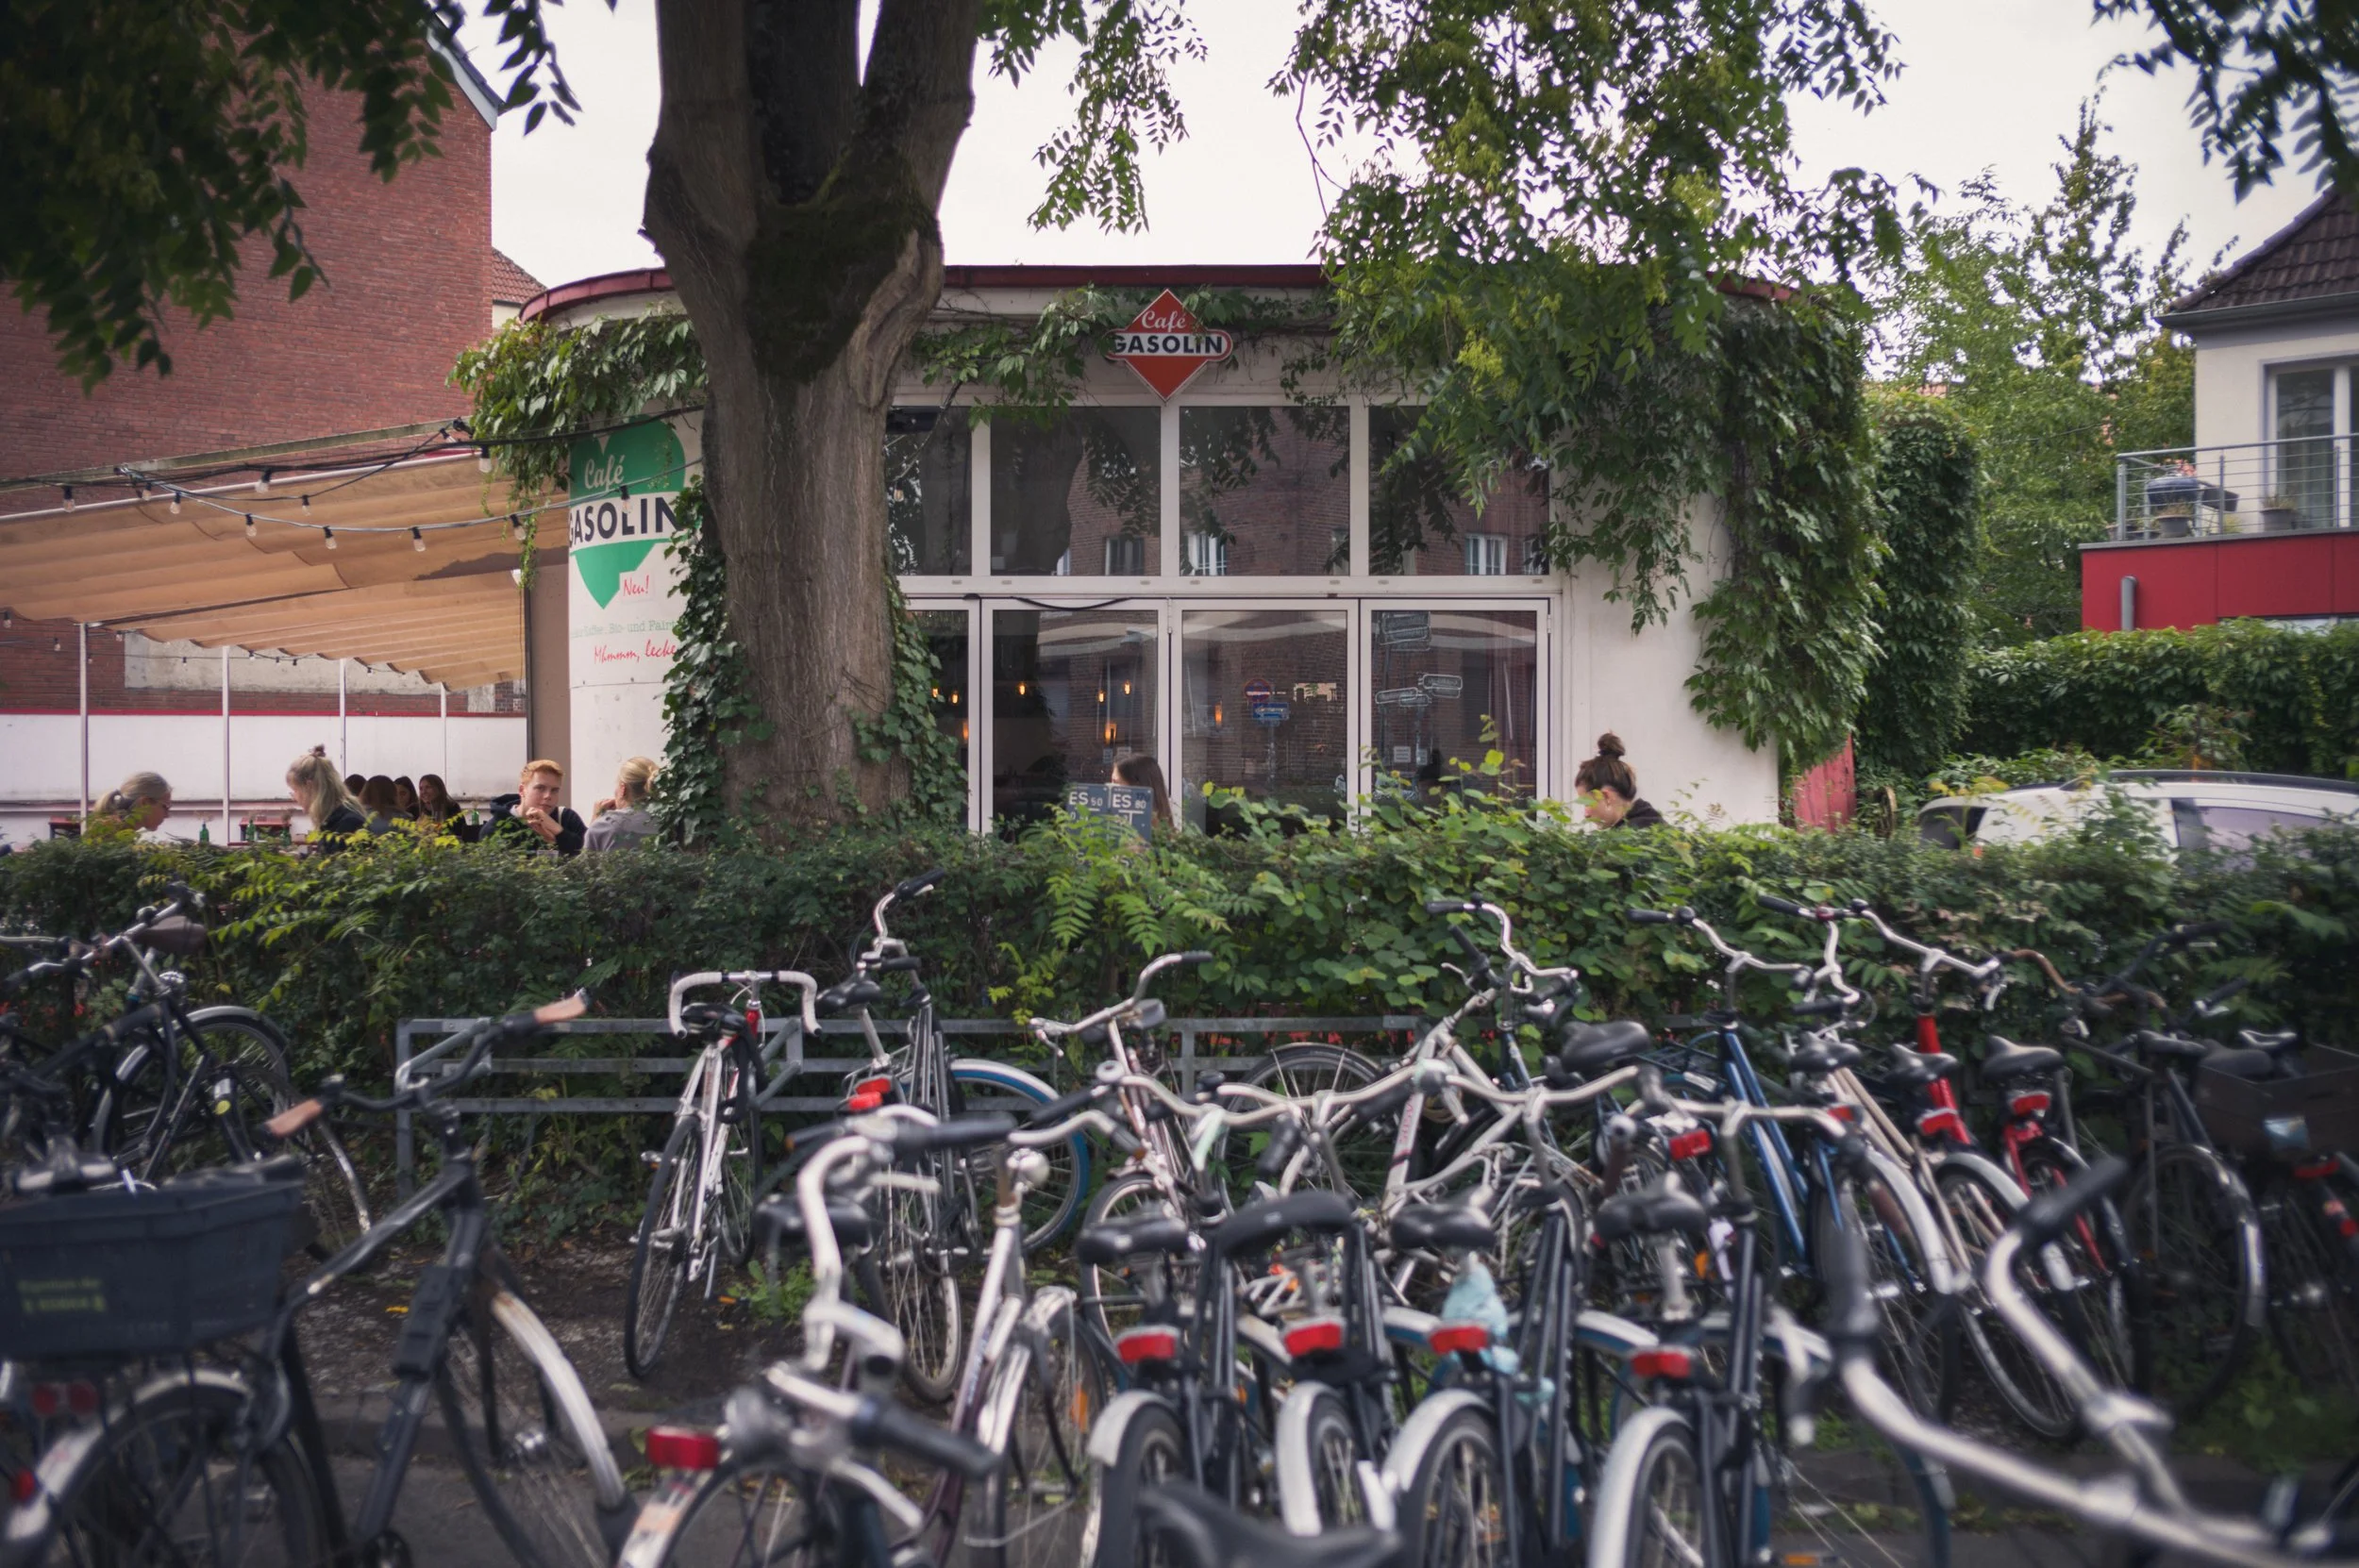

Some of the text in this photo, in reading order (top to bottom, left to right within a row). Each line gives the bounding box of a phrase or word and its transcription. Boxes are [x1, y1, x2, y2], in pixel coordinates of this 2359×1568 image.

[1142, 310, 1186, 332] Café
[1114, 335, 1222, 354] GASOLIN
[584, 455, 626, 492] Café
[623, 575, 649, 595] Neu!
[1068, 792, 1089, 806] ES
[1113, 793, 1132, 808] ES
